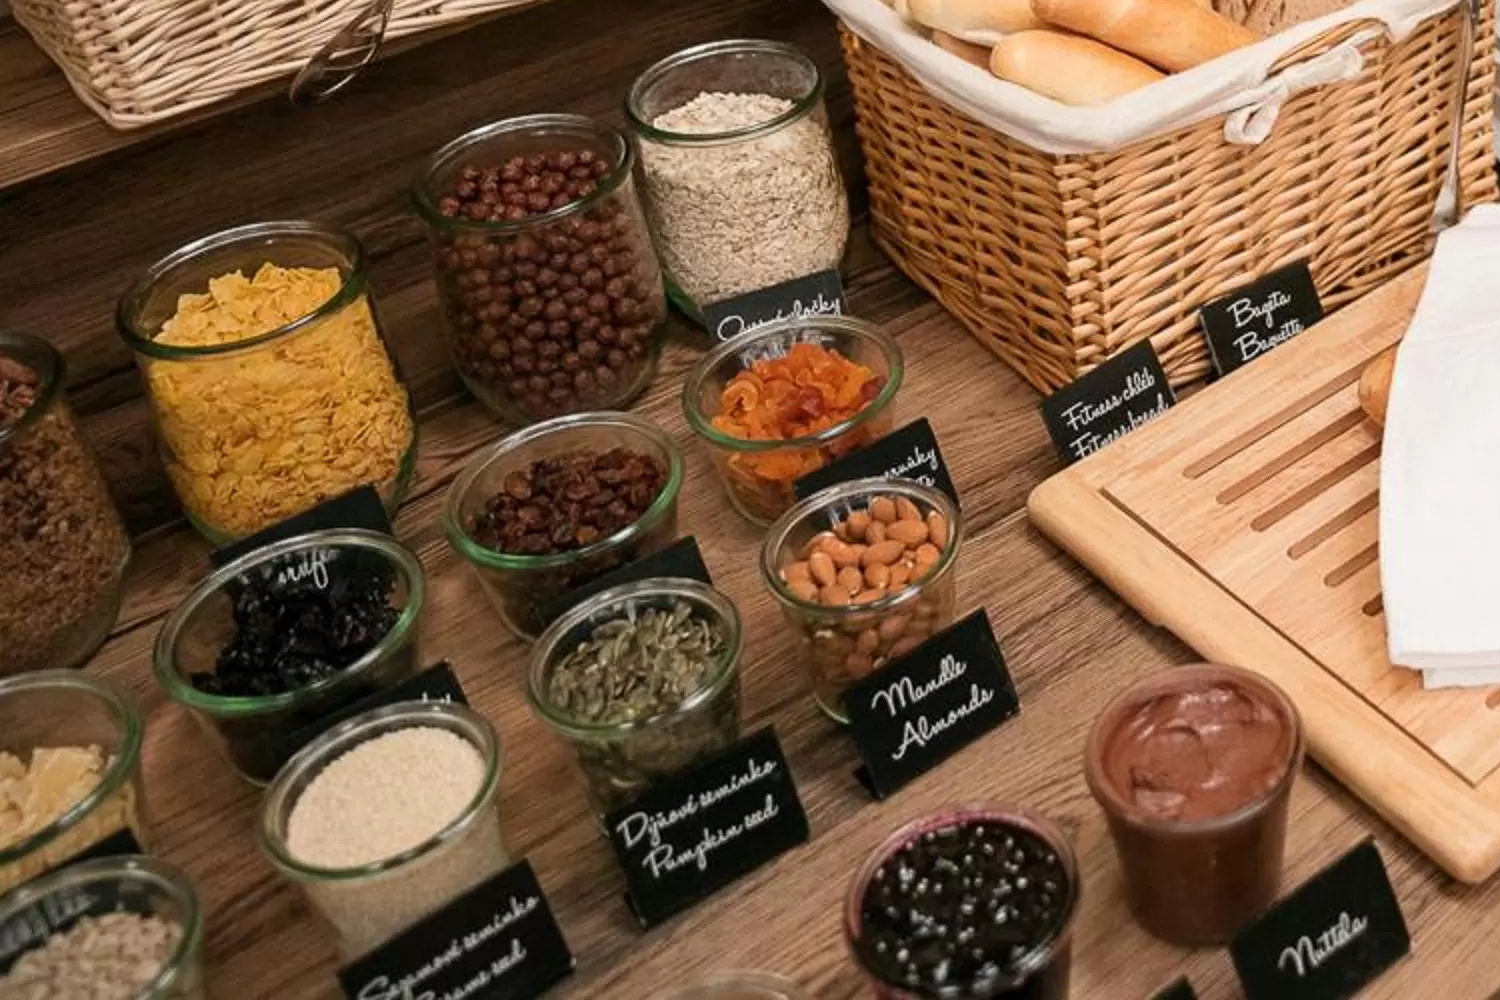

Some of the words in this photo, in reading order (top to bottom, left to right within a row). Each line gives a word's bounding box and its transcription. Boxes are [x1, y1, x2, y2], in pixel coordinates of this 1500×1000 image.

[1225, 290, 1291, 329] Bageta
[1060, 395, 1123, 431] Fitness
[1123, 366, 1156, 401] chléb
[871, 653, 967, 718] Mandle
[891, 683, 995, 761] Almonds
[699, 757, 778, 807] semínko
[641, 827, 743, 879] Pumpkin
[743, 793, 780, 830] seed
